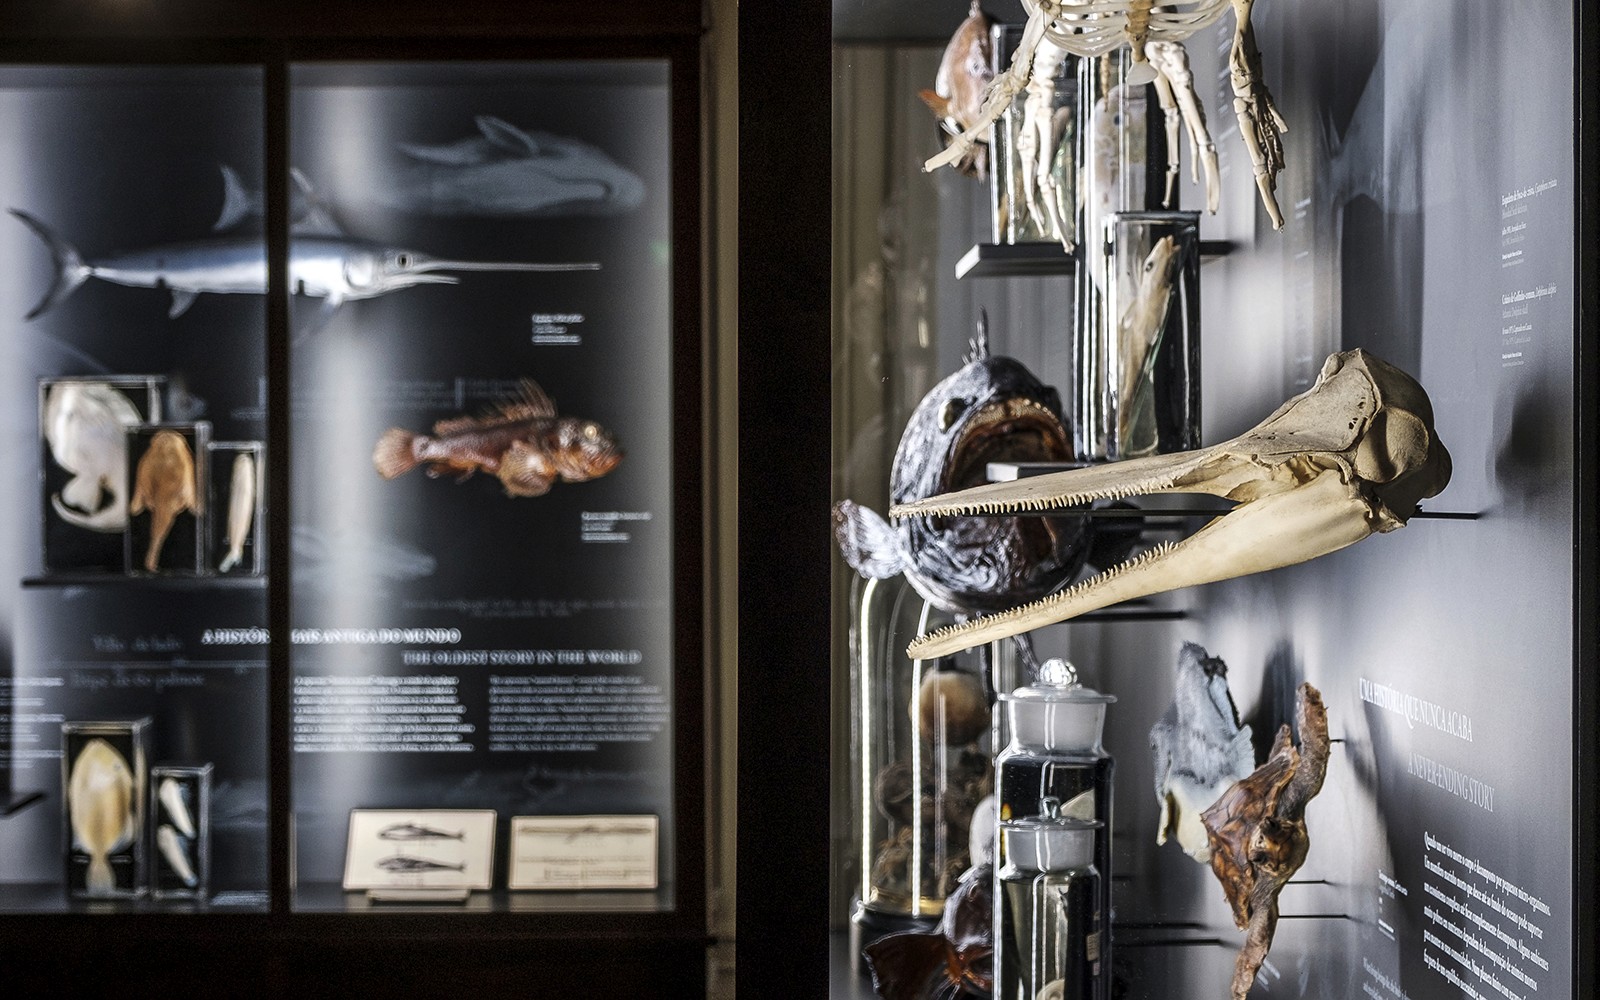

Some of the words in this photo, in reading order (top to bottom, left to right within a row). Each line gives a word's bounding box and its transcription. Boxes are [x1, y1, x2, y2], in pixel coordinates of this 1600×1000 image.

[214, 626, 271, 645] HISTÓR
[1413, 753, 1468, 801] NEVER-ENDING
[1469, 778, 1495, 812] STORY
